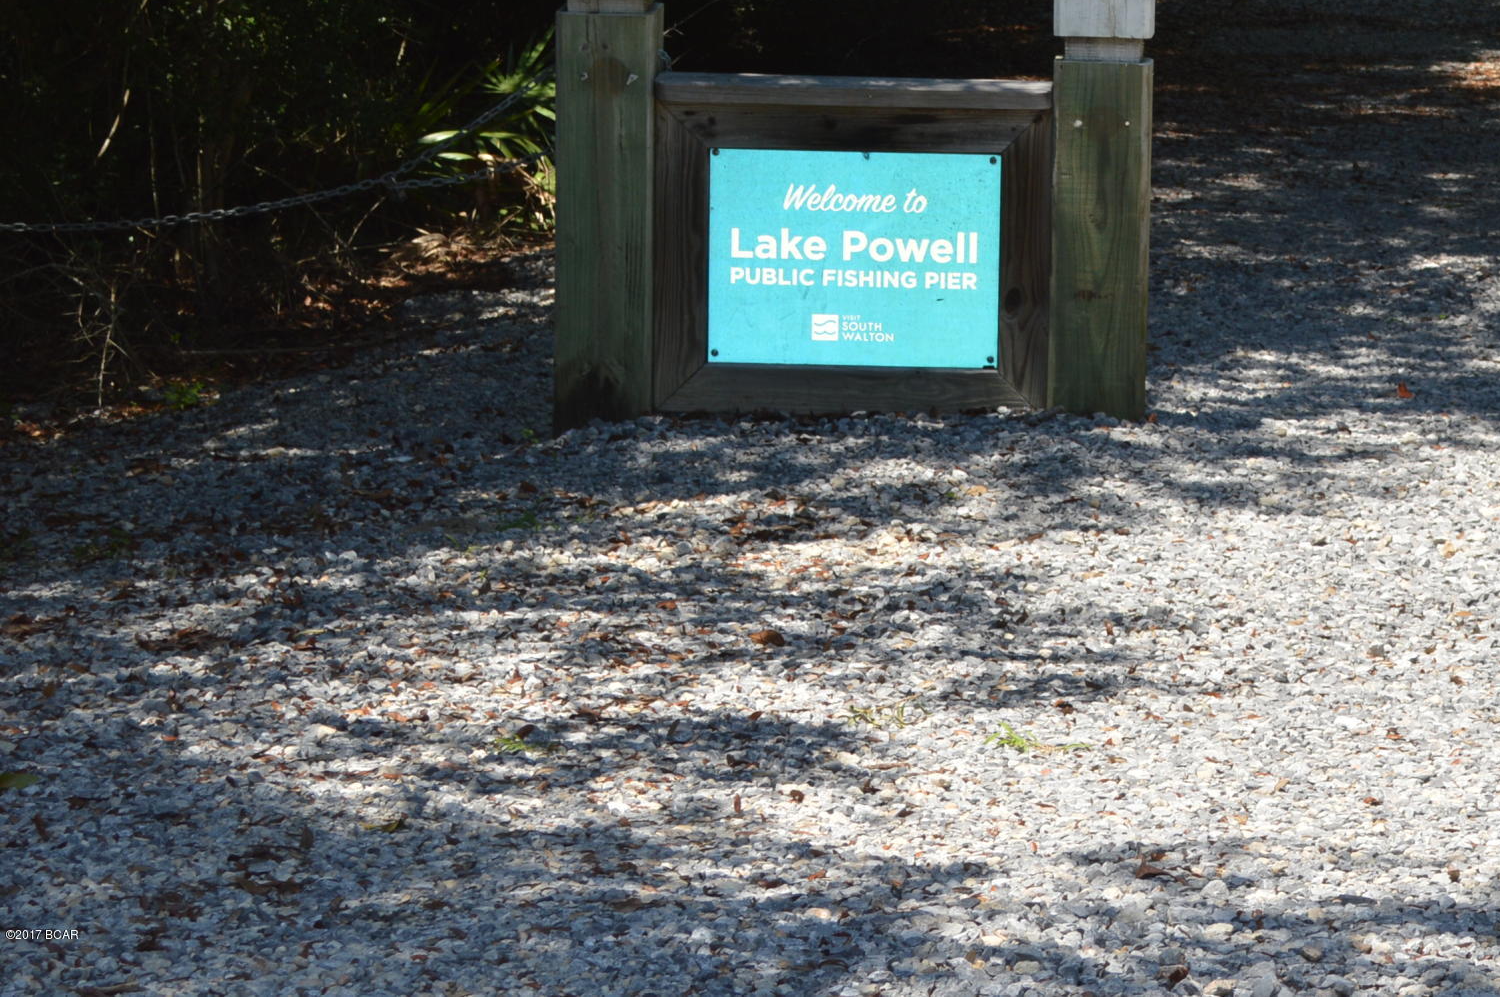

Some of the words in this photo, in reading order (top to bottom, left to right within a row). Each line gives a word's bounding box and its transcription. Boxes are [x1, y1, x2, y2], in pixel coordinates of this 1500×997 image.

[783, 183, 897, 213] Welcome
[903, 188, 929, 213] to
[730, 227, 828, 261] Lake
[842, 230, 978, 264] Powell
[730, 267, 815, 286] PUBLIC
[822, 269, 918, 289] FISHING
[924, 271, 978, 290] PIER
[842, 321, 882, 332] SOUTH
[842, 331, 895, 342] WALTON
